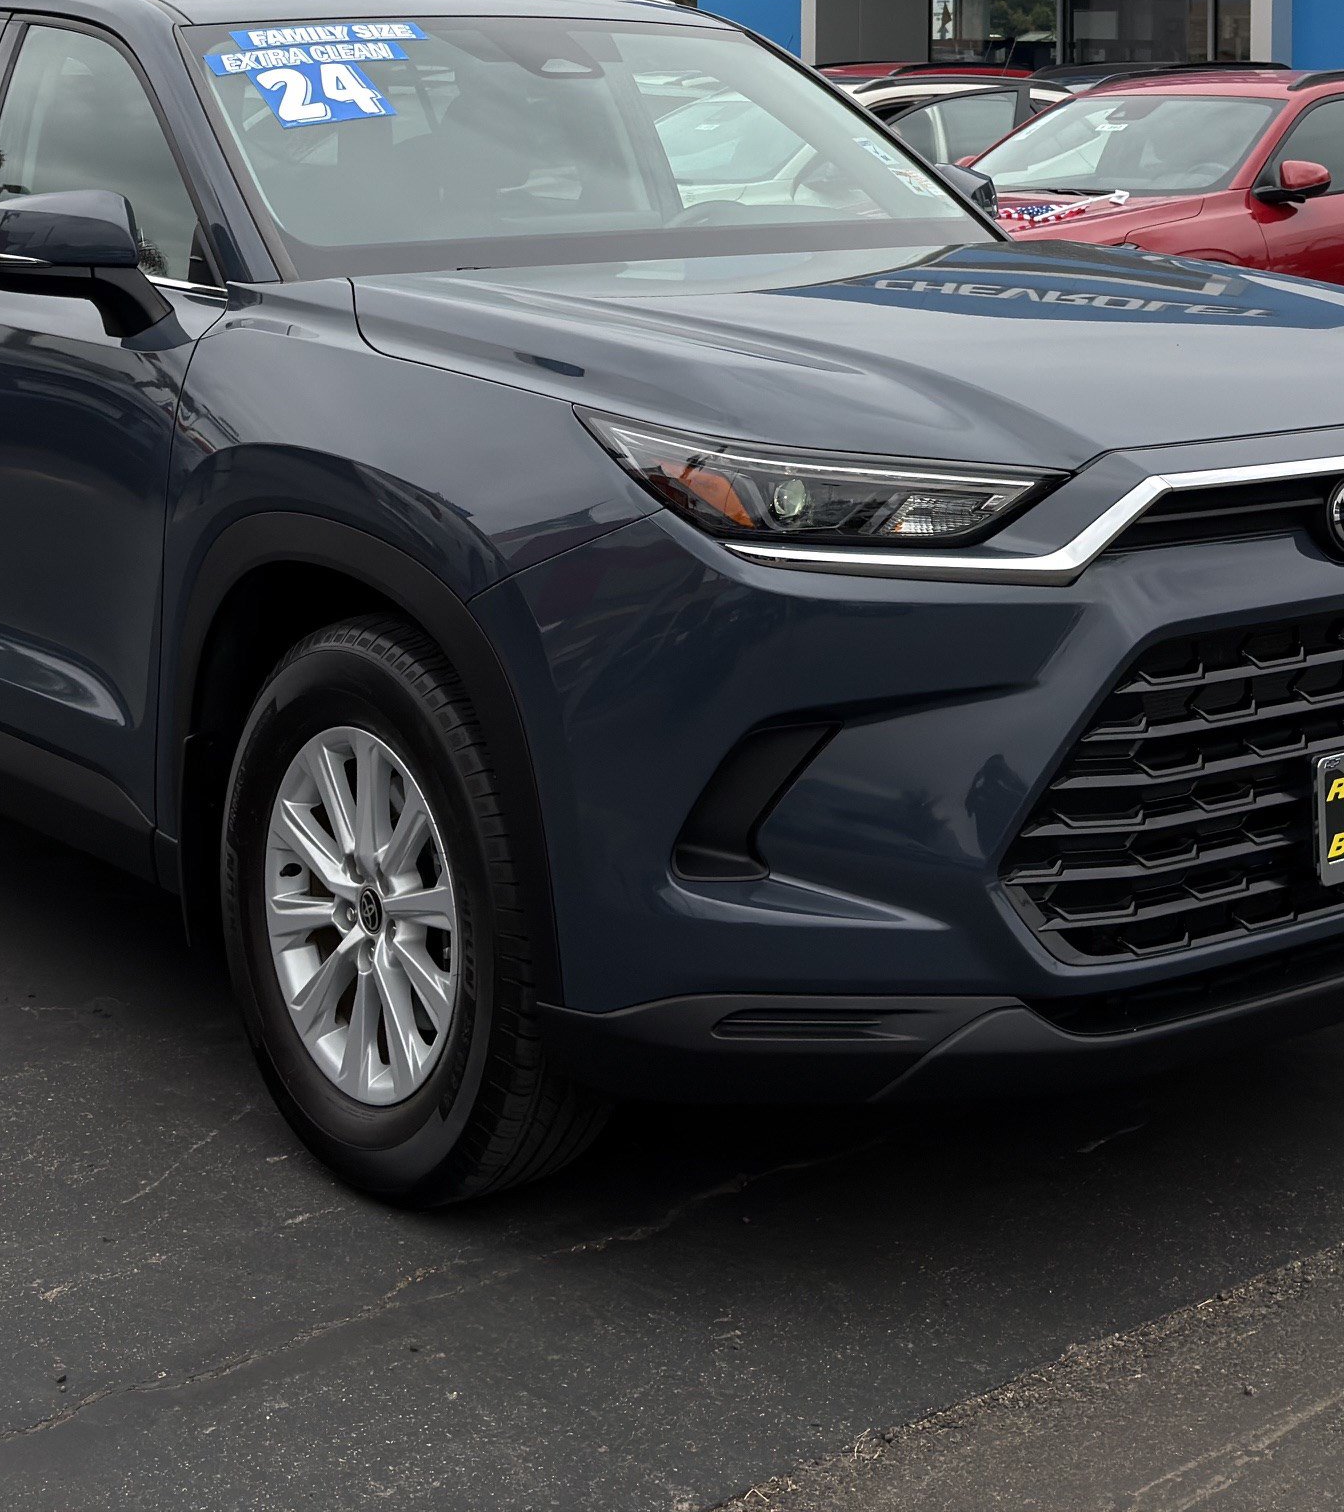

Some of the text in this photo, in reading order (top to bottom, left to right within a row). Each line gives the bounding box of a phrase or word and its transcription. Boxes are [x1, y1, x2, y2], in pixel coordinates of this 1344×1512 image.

[247, 23, 417, 47] FAMILY SIZE
[220, 42, 394, 73] EXTRA CLEAN
[256, 63, 386, 123] 24
